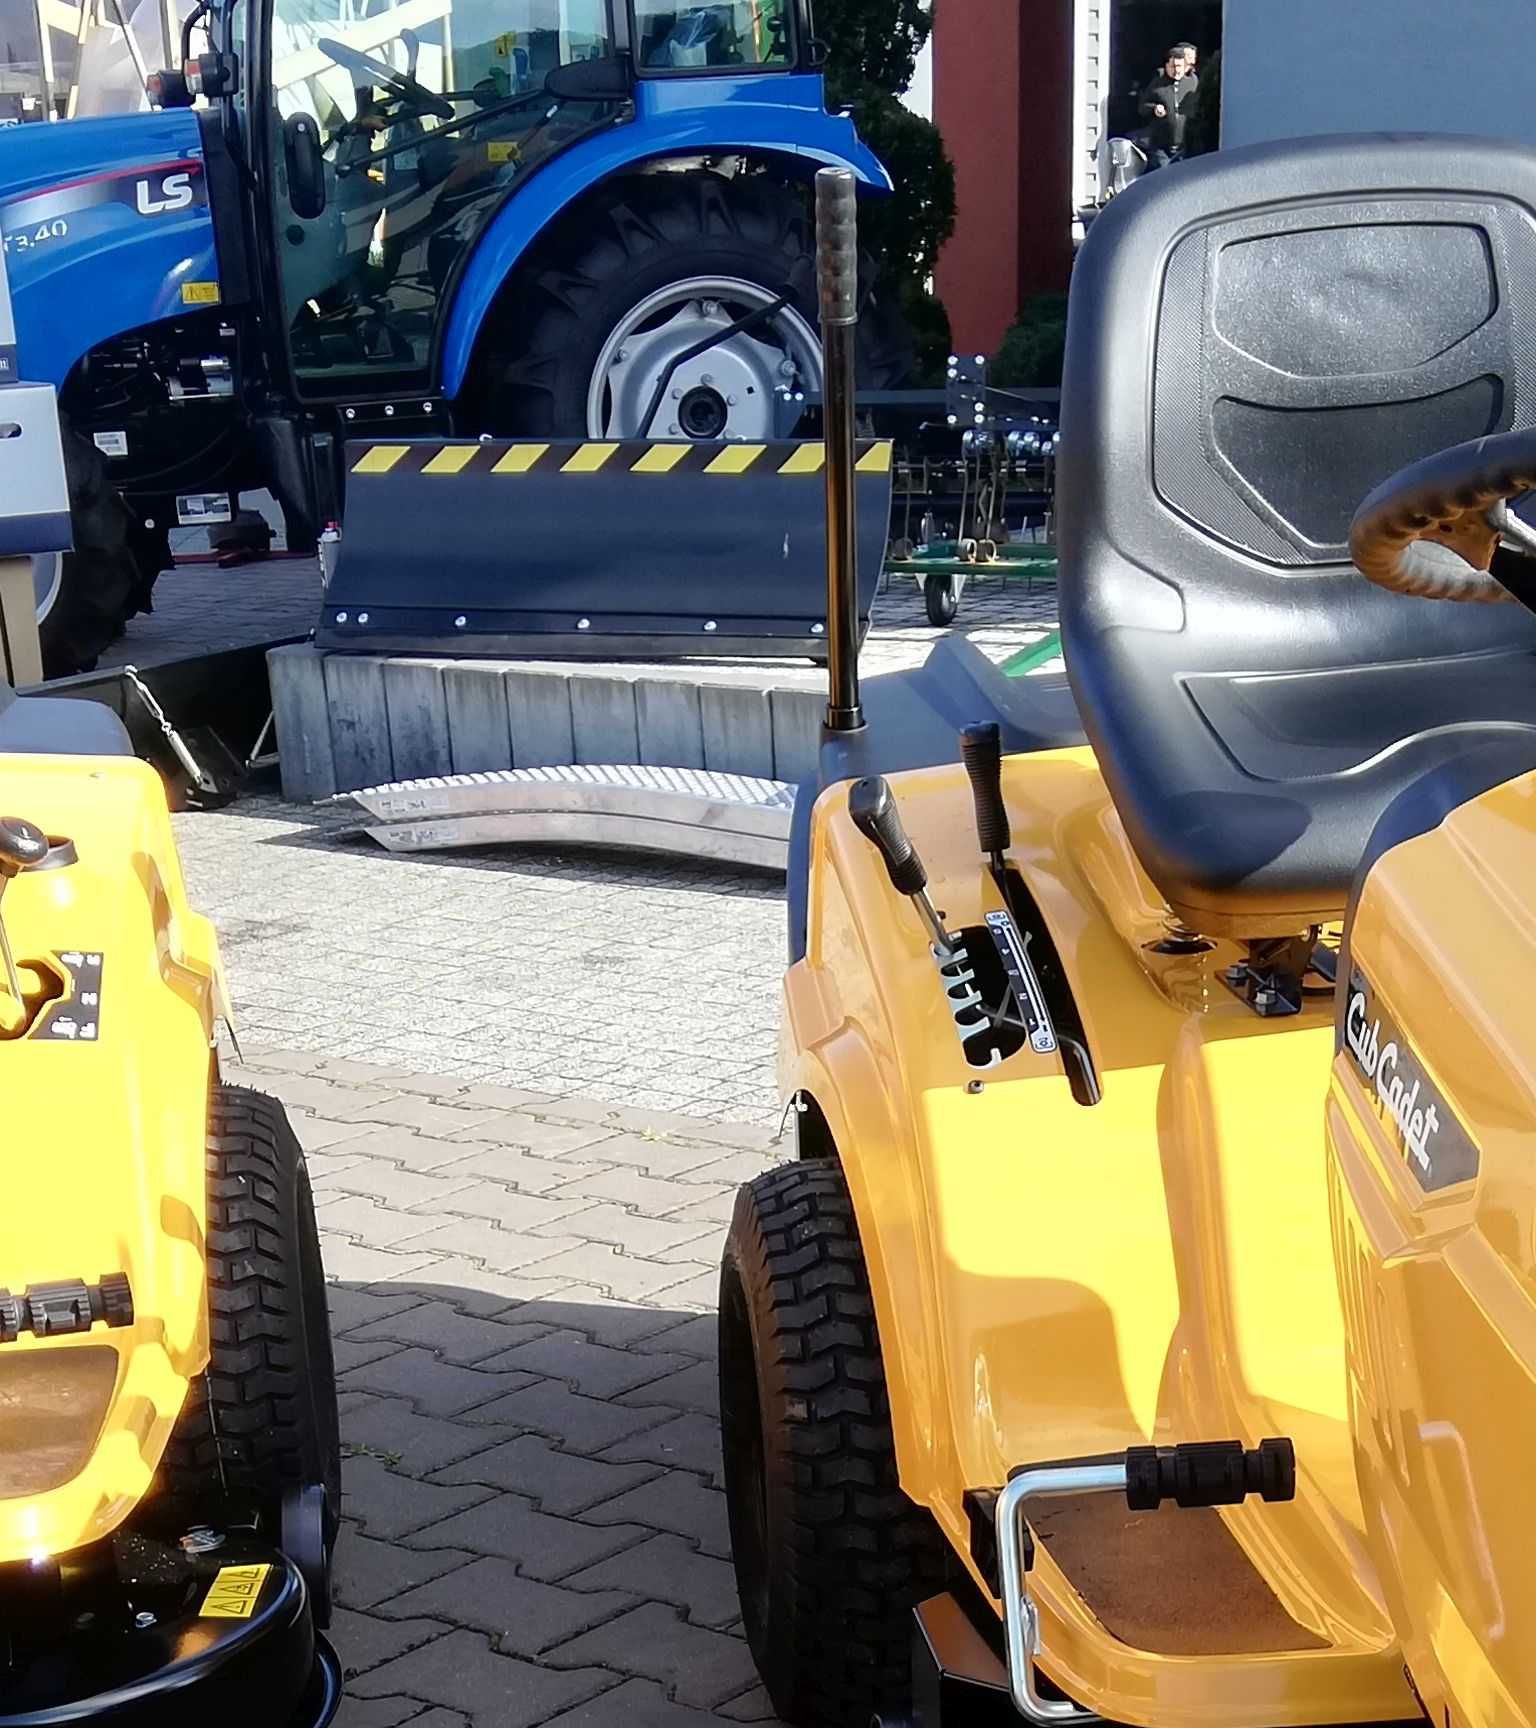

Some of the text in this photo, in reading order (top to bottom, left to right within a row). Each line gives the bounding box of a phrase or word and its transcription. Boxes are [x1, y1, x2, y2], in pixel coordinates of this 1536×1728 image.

[136, 172, 193, 215] LS
[1346, 991, 1440, 1172] Cub Cadet
